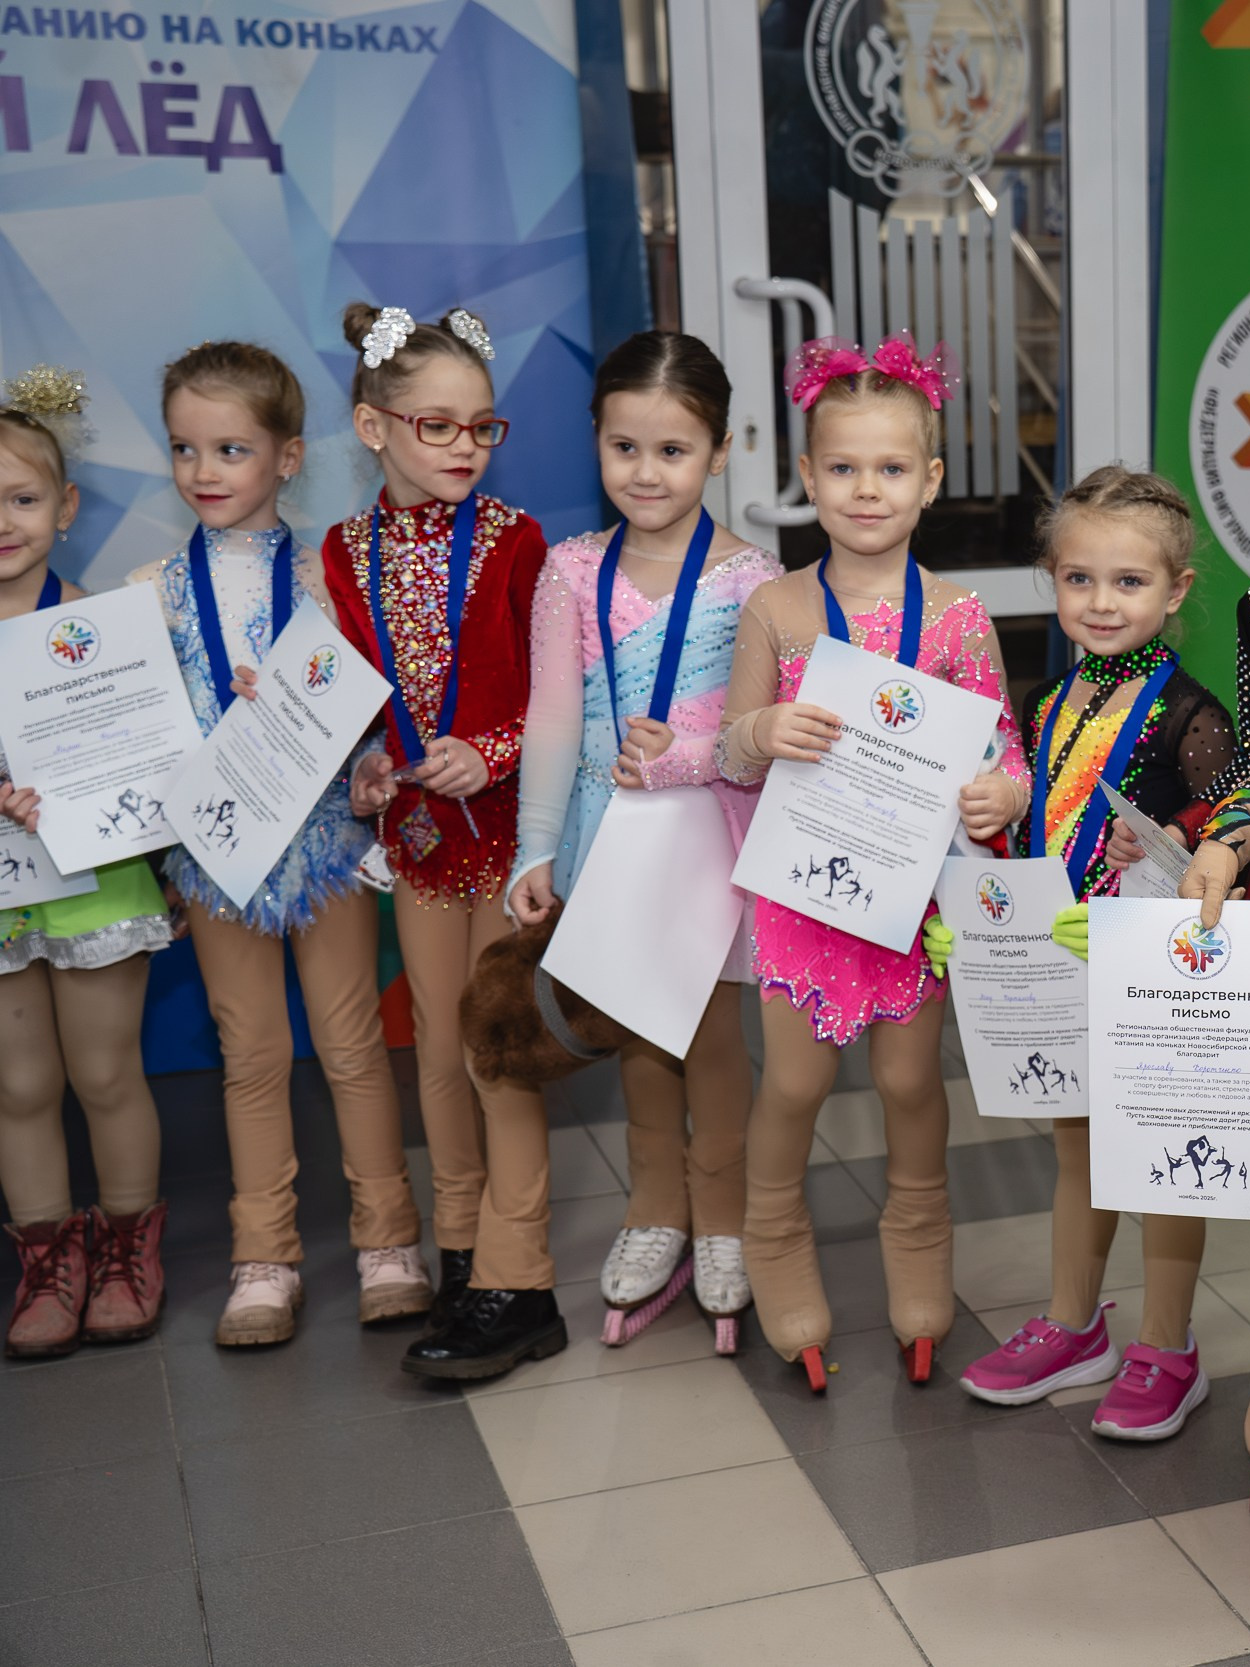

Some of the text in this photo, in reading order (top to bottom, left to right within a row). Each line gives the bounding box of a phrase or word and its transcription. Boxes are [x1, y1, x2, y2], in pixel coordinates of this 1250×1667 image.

[161, 14, 223, 46] НА
[235, 17, 440, 55] КОНЬКАХ
[65, 59, 285, 175] ЛЁД
[24, 658, 148, 702] Благодарственное
[66, 682, 116, 706] письмо
[856, 746, 905, 773] письмо
[989, 949, 1028, 958] письмо
[1171, 1008, 1231, 1019] письмо
[1116, 1023, 1168, 1031] Региональная
[1169, 1025, 1224, 1033] общественная
[1107, 1031, 1150, 1039] спортивная
[1151, 1033, 1200, 1041] организация
[1201, 1034, 1248, 1043] «Федерация
[1187, 1042, 1247, 1051] Новосибирской
[1176, 1050, 1220, 1058] благодарит
[1157, 1083, 1192, 1091] фигурного
[1132, 1090, 1179, 1098] совершенству
[1121, 1104, 1164, 1112] пожеланием
[1187, 1108, 1230, 1116] достижений
[1187, 1122, 1230, 1130] приближает
